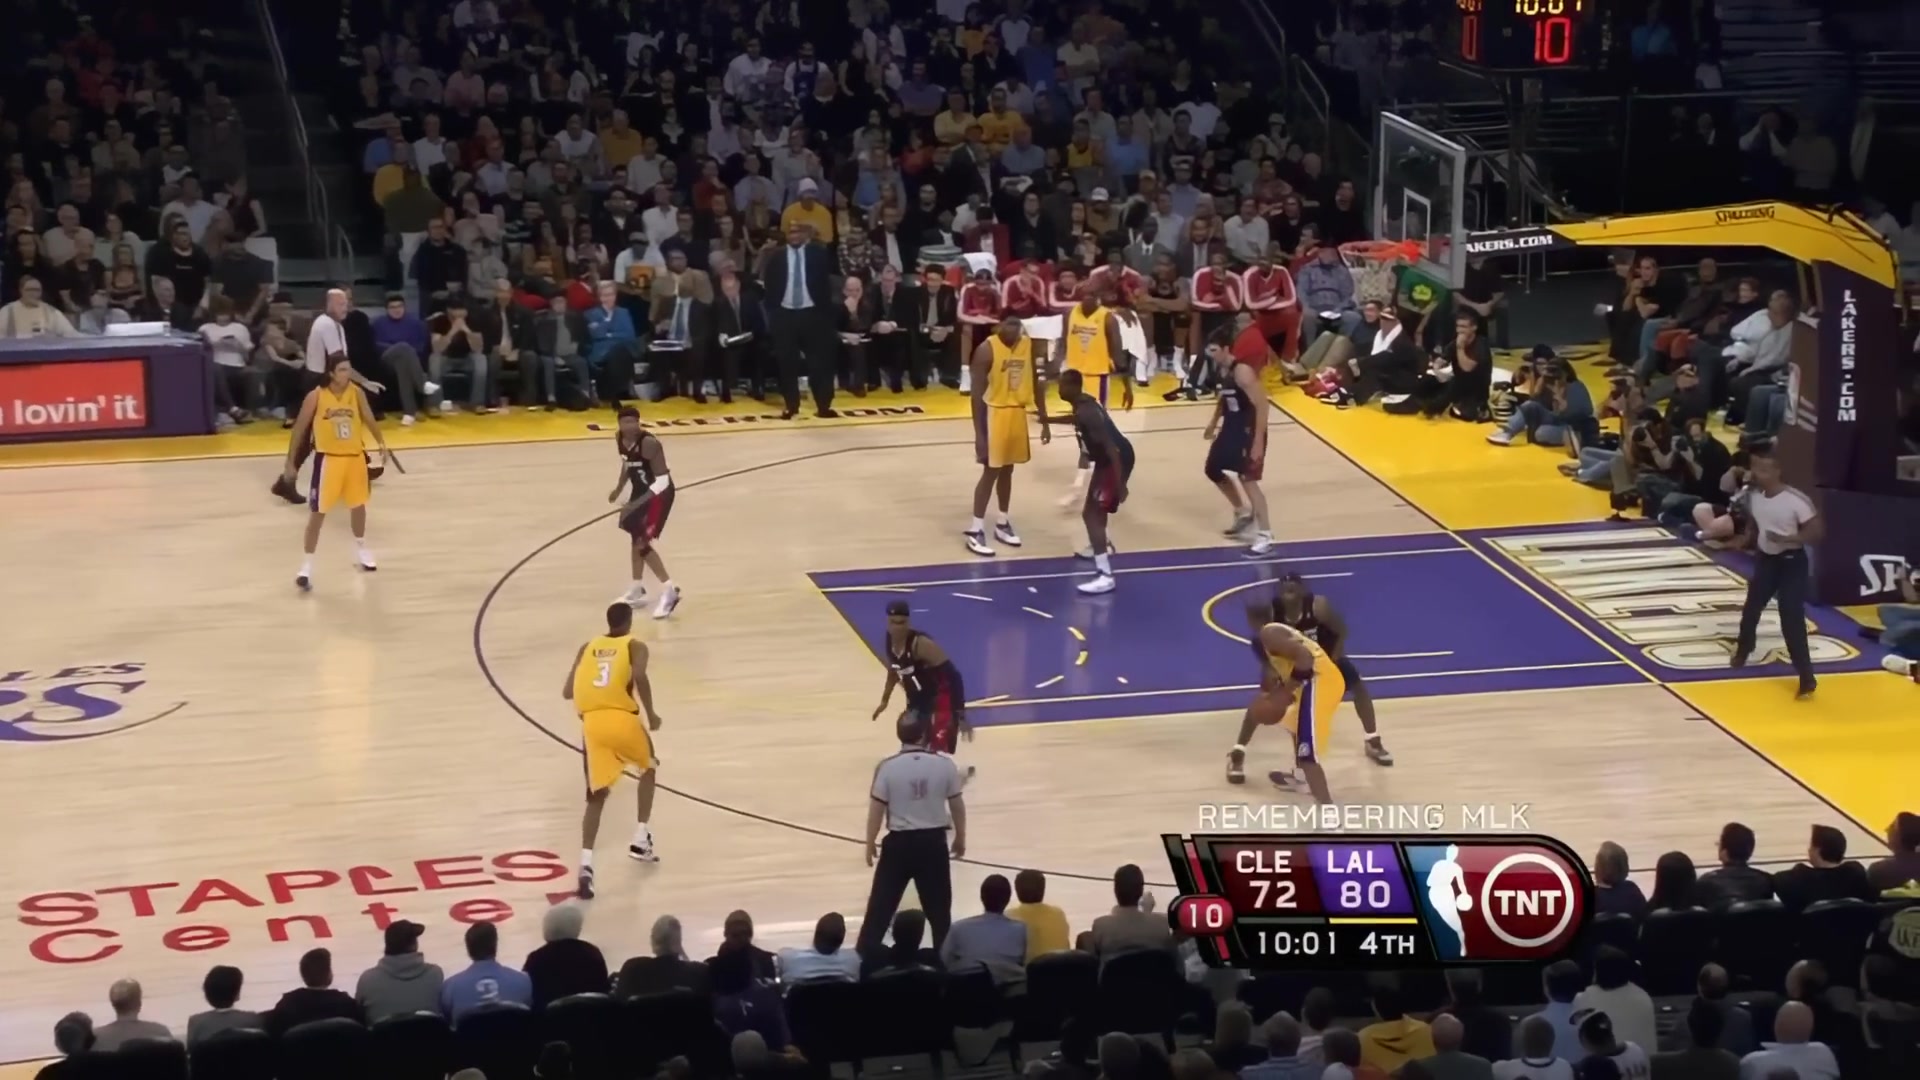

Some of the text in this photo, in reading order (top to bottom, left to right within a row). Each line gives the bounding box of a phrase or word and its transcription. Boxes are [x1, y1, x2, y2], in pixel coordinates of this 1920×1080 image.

[1534, 17, 1571, 63] 10
[1466, 235, 1553, 253] AKERS.COM
[1837, 289, 1857, 422] LAKERS.COM
[14, 395, 106, 426] lovin'
[113, 395, 143, 420] it
[593, 661, 610, 687] 3
[19, 850, 569, 927] STAPLES
